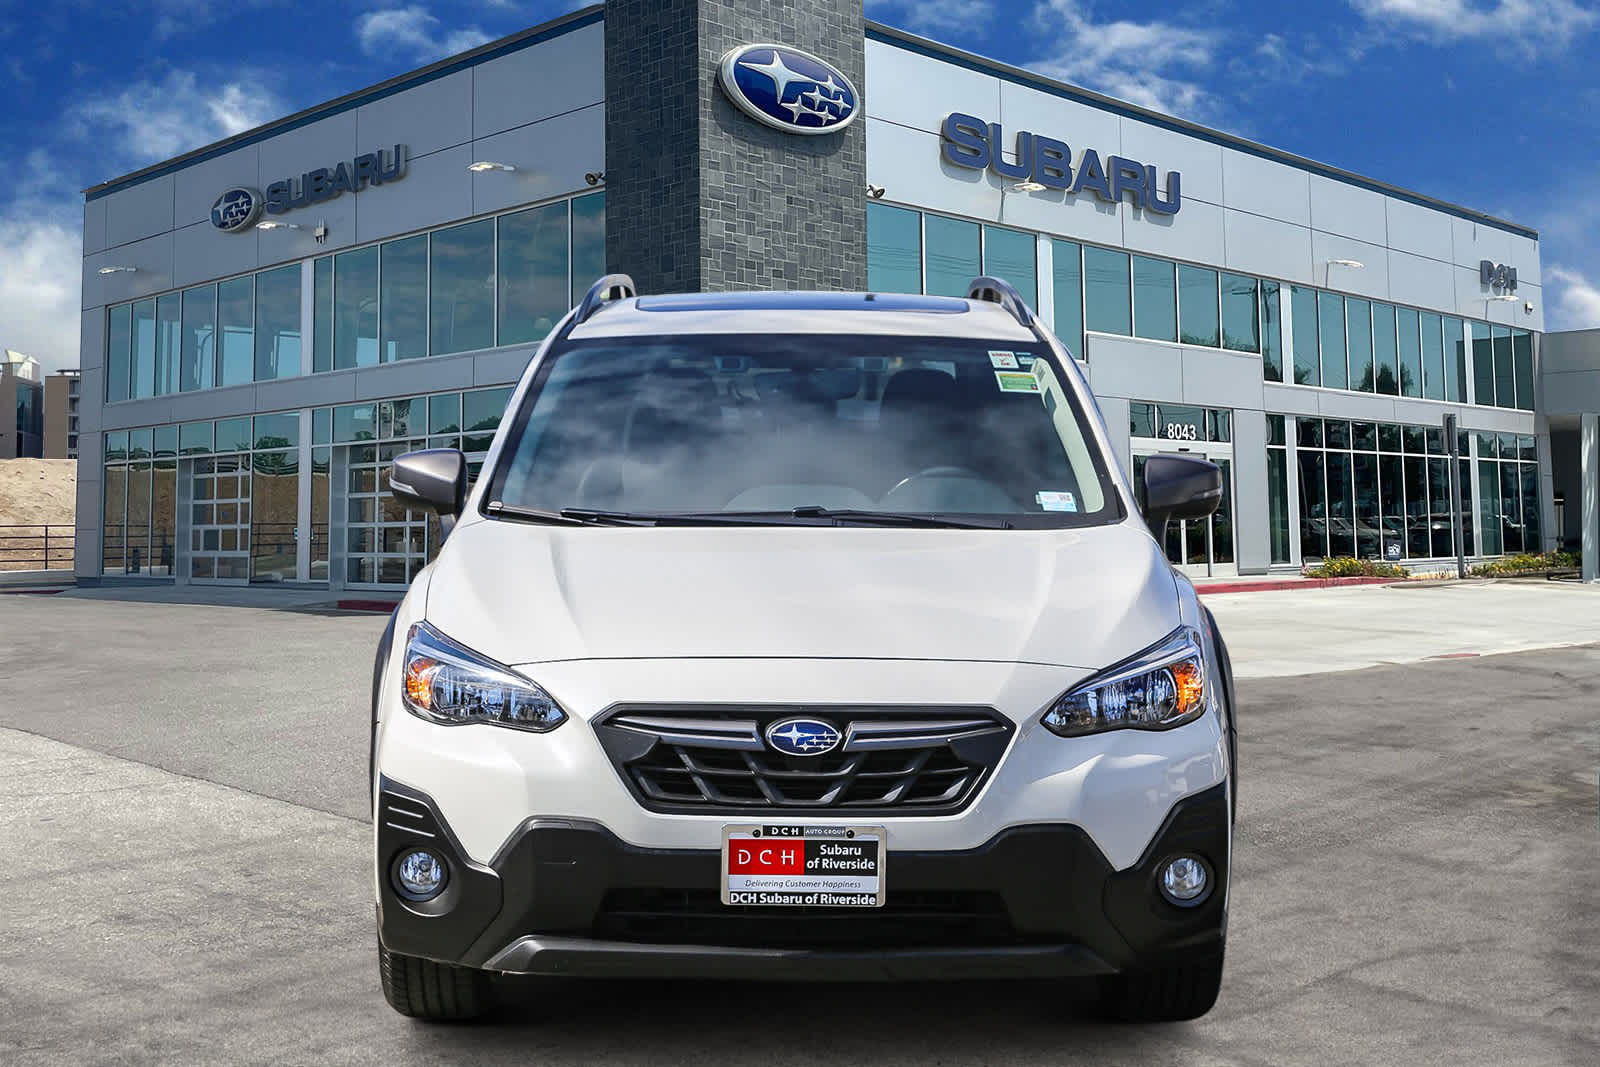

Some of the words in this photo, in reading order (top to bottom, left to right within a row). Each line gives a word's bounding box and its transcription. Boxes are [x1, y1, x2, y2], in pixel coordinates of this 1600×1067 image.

[942, 112, 1181, 215] SUBARU
[265, 144, 405, 215] SUBARU
[1167, 423, 1196, 440] 8043
[823, 828, 846, 836] GROUP
[820, 844, 862, 856] Subaru
[806, 858, 821, 869] of
[822, 858, 875, 870] Riverside
[745, 879, 783, 889] Delivering
[785, 879, 821, 888] Customer
[822, 880, 861, 889] Happiness
[730, 892, 757, 904] DCH
[759, 892, 803, 904] Subaru
[805, 892, 819, 905] of
[820, 893, 876, 905] Riverside
